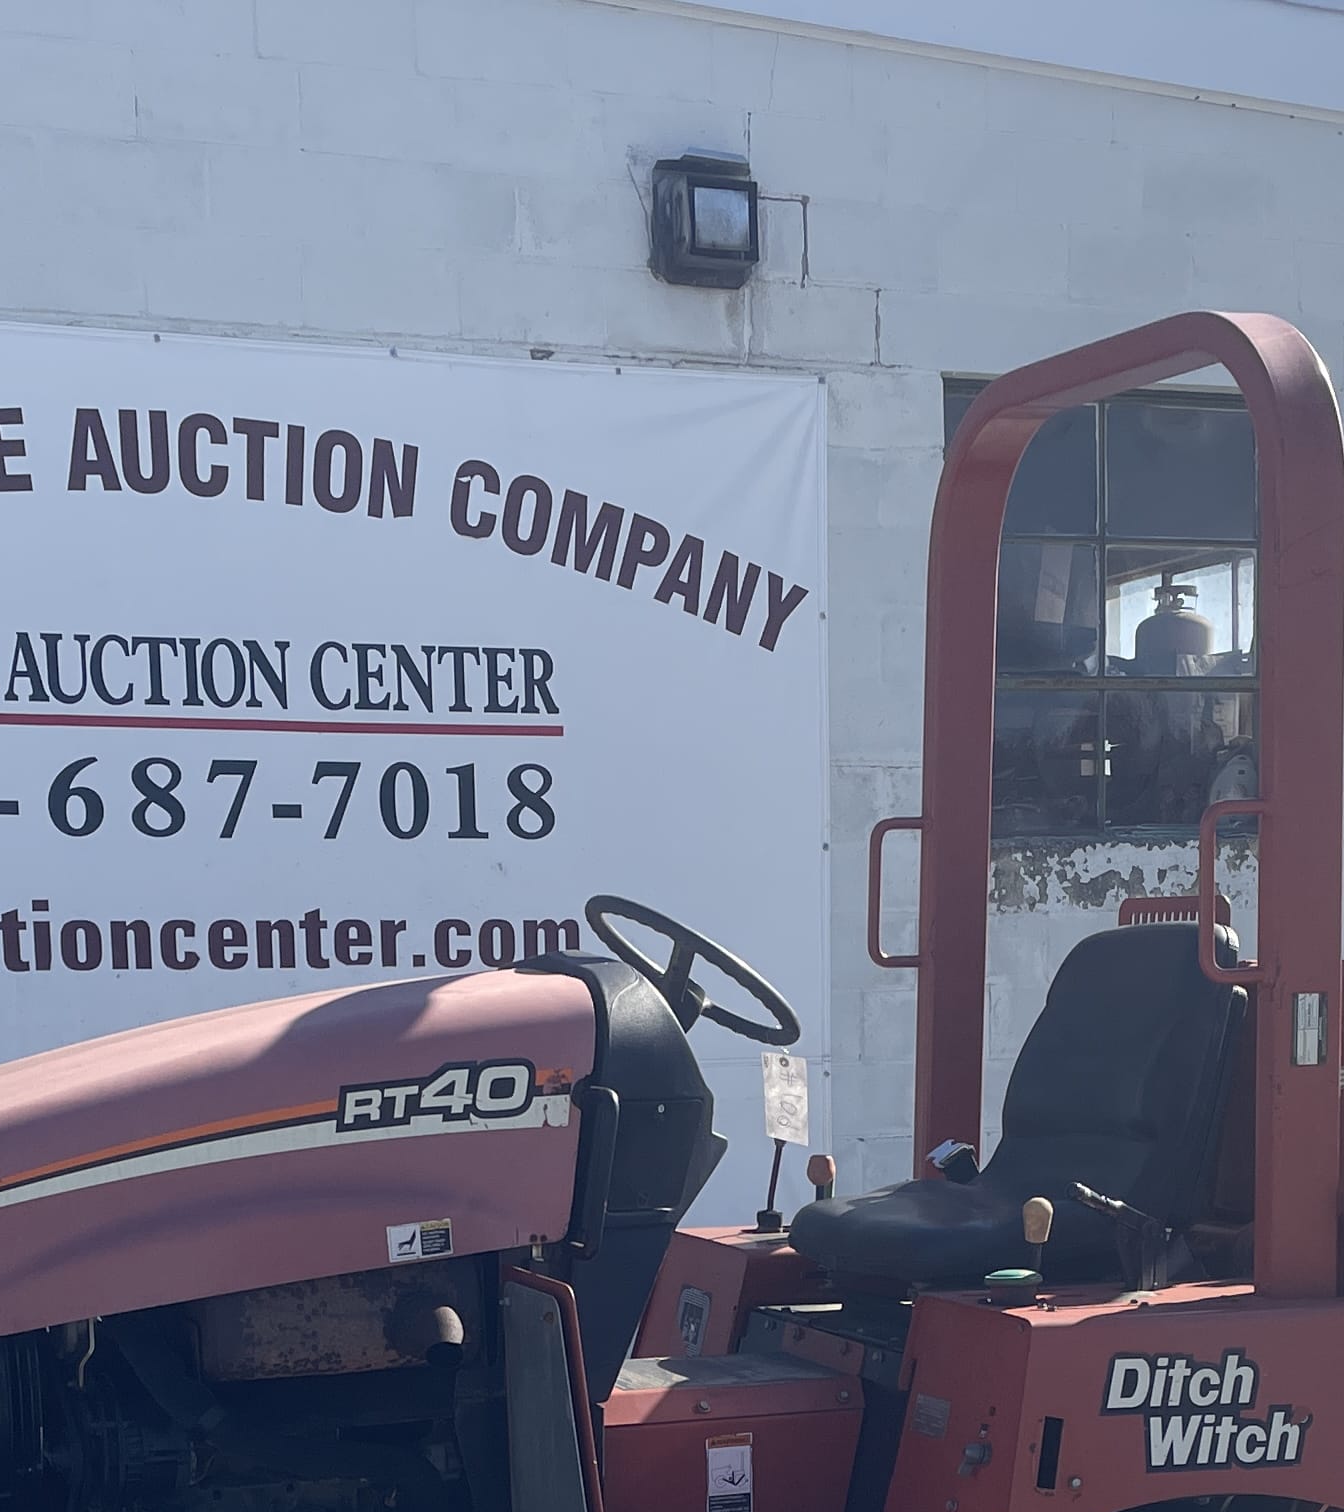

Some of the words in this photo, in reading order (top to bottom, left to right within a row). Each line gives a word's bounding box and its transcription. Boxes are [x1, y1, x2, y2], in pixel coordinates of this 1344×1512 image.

[67, 408, 419, 519] AUCTION
[450, 459, 810, 652] COMPANY
[4, 631, 291, 710] AUCTION
[309, 640, 560, 715] CENTER
[343, 1065, 530, 1125] RT40
[1107, 1354, 1255, 1409] Ditch
[1149, 1411, 1301, 1467] Witch
